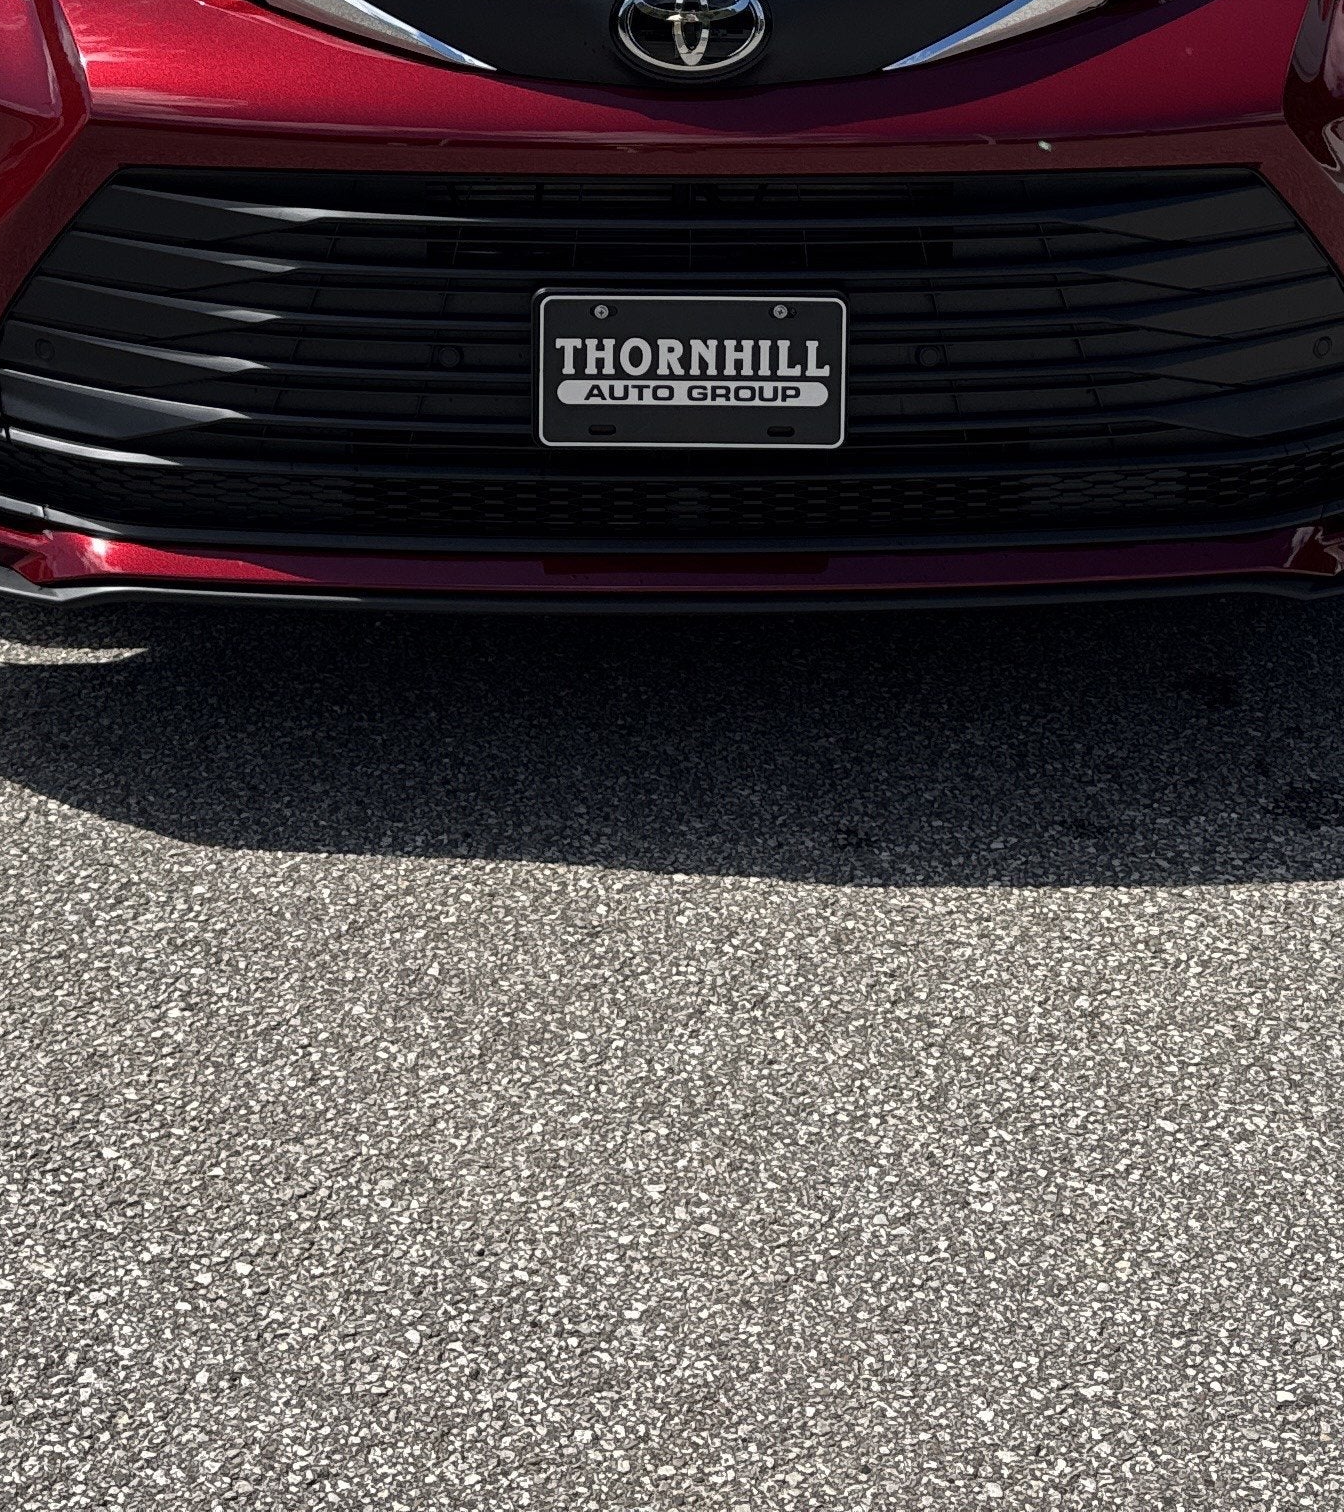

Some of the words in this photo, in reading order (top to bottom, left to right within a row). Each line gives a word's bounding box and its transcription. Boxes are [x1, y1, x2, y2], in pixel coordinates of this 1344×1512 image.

[555, 337, 831, 377] THORNHILL
[583, 384, 676, 402] AUTO
[686, 385, 802, 403] GROUP
